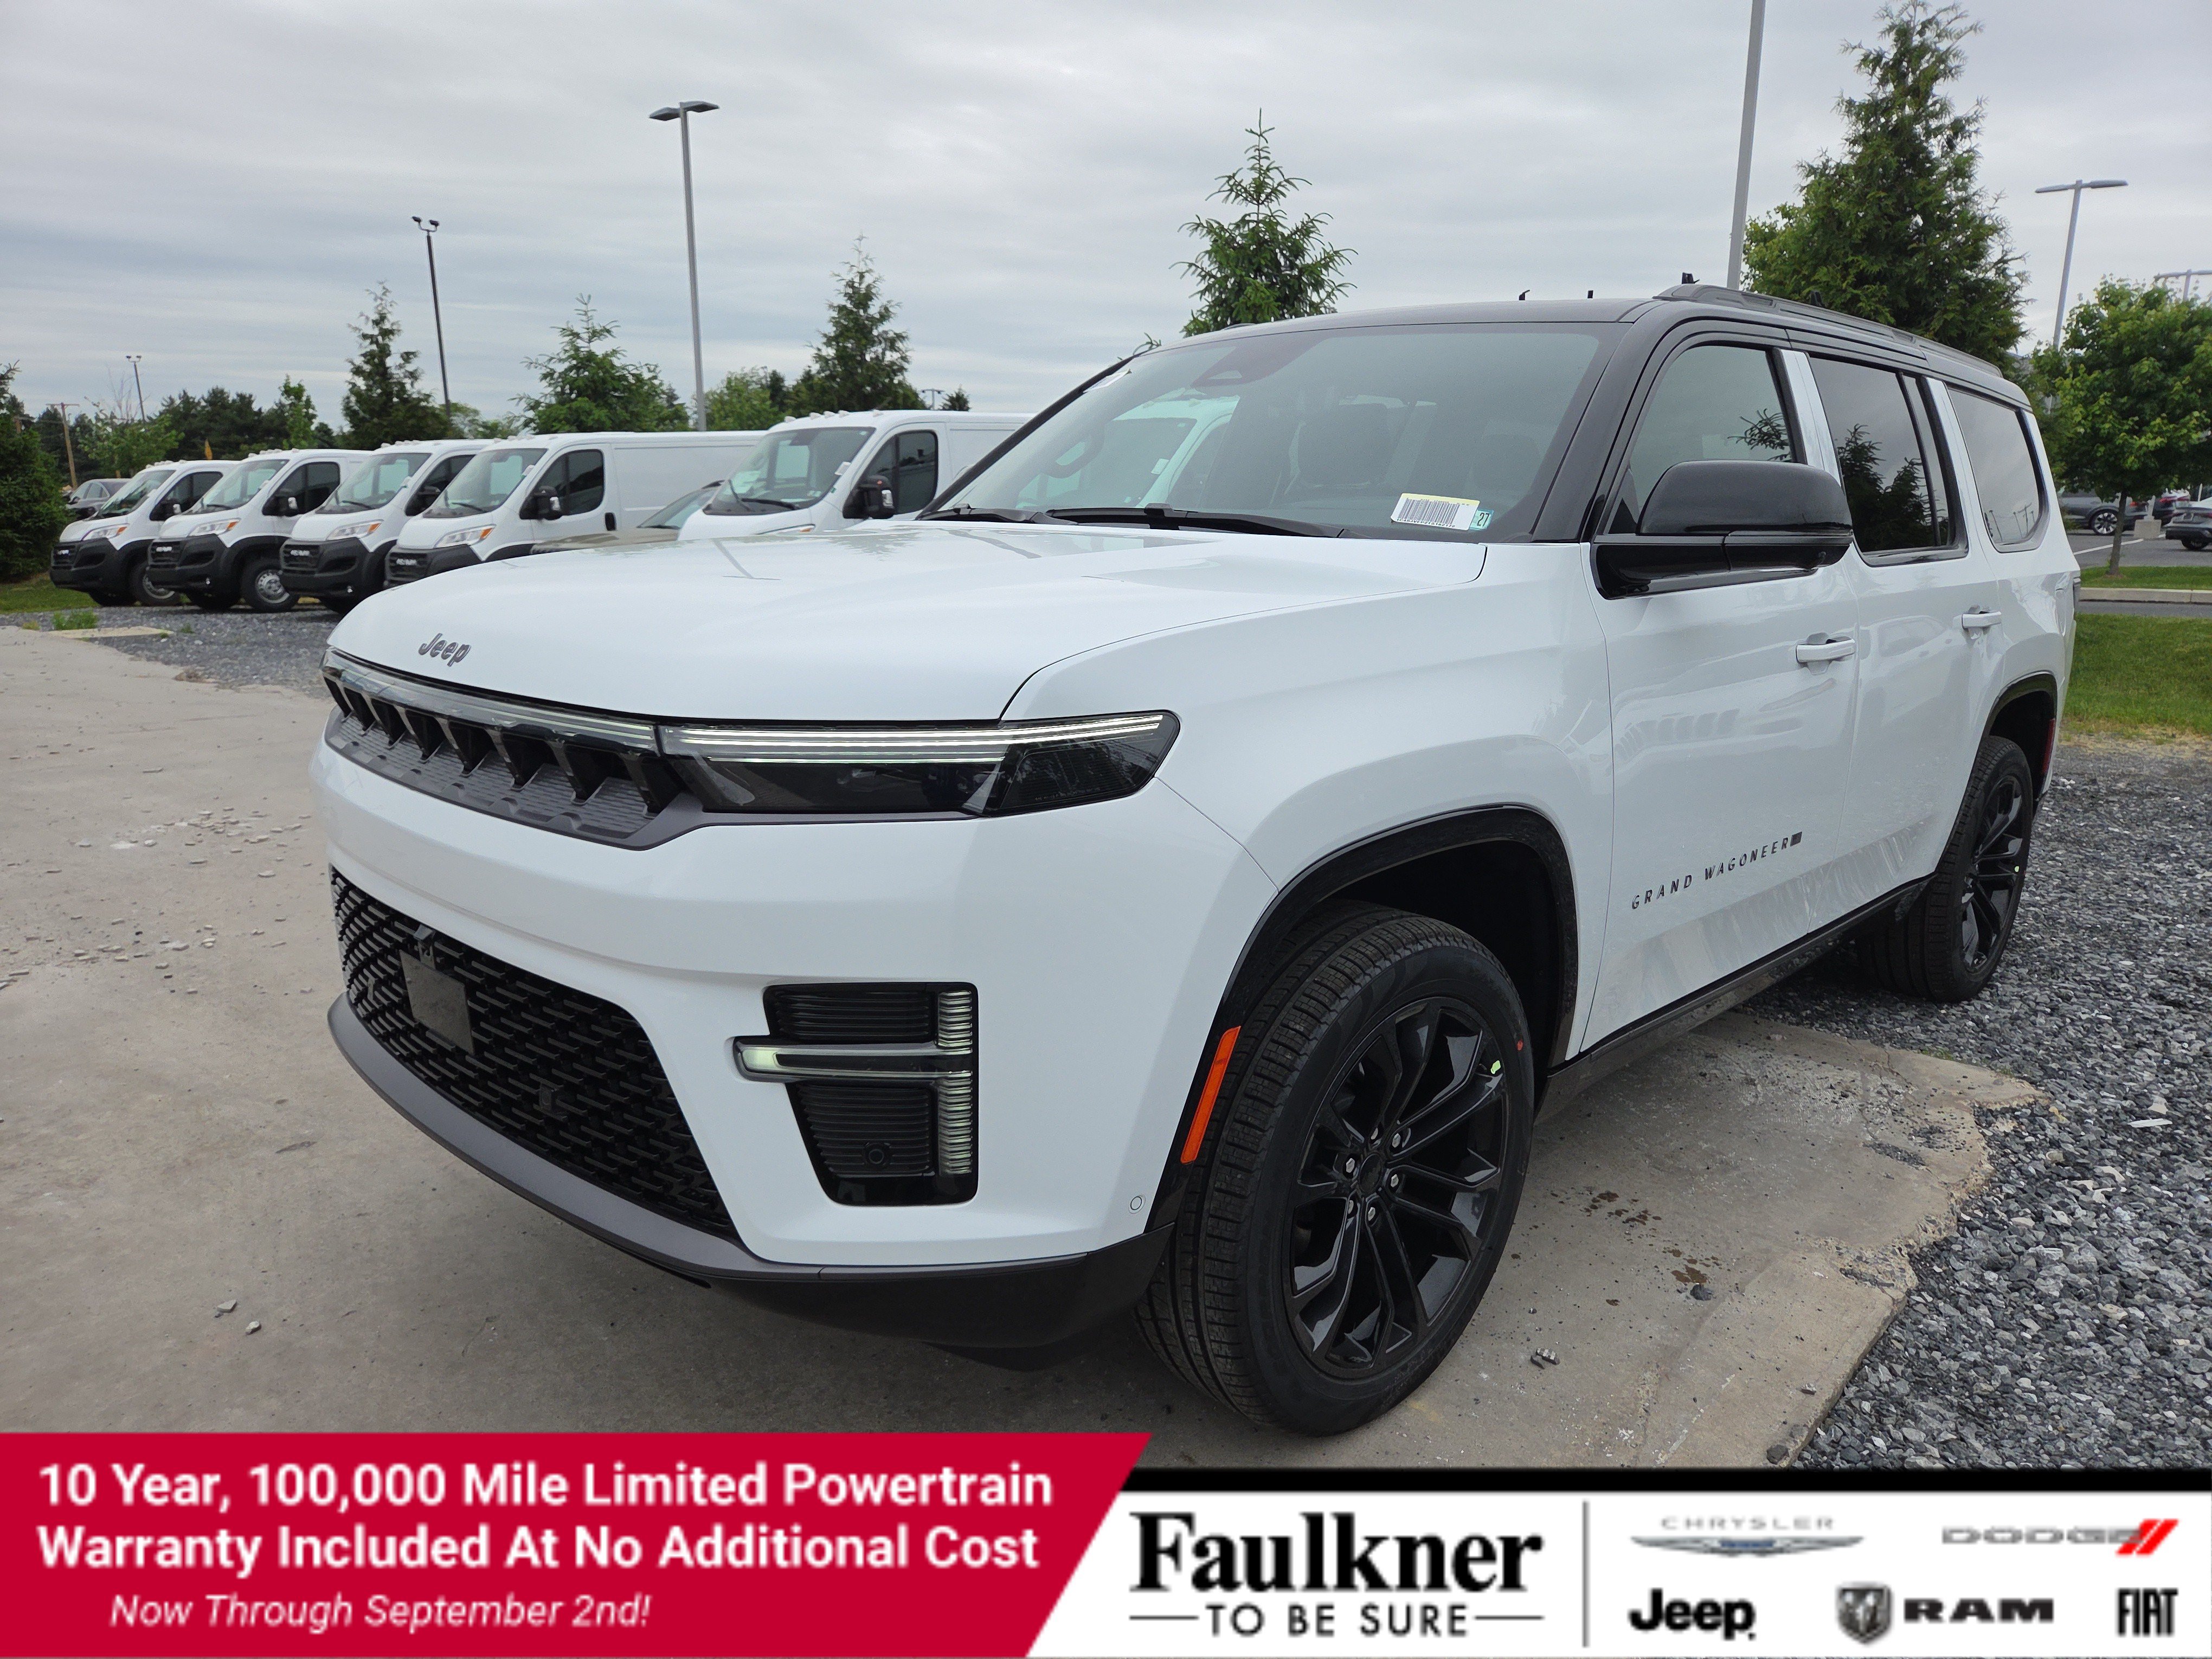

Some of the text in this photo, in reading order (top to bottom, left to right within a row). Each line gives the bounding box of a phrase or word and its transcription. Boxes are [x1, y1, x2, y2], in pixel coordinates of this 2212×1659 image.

[1477, 512, 1490, 527] 27
[419, 632, 472, 667] Jeep
[1631, 837, 1789, 910] GRAND WAGONEER
